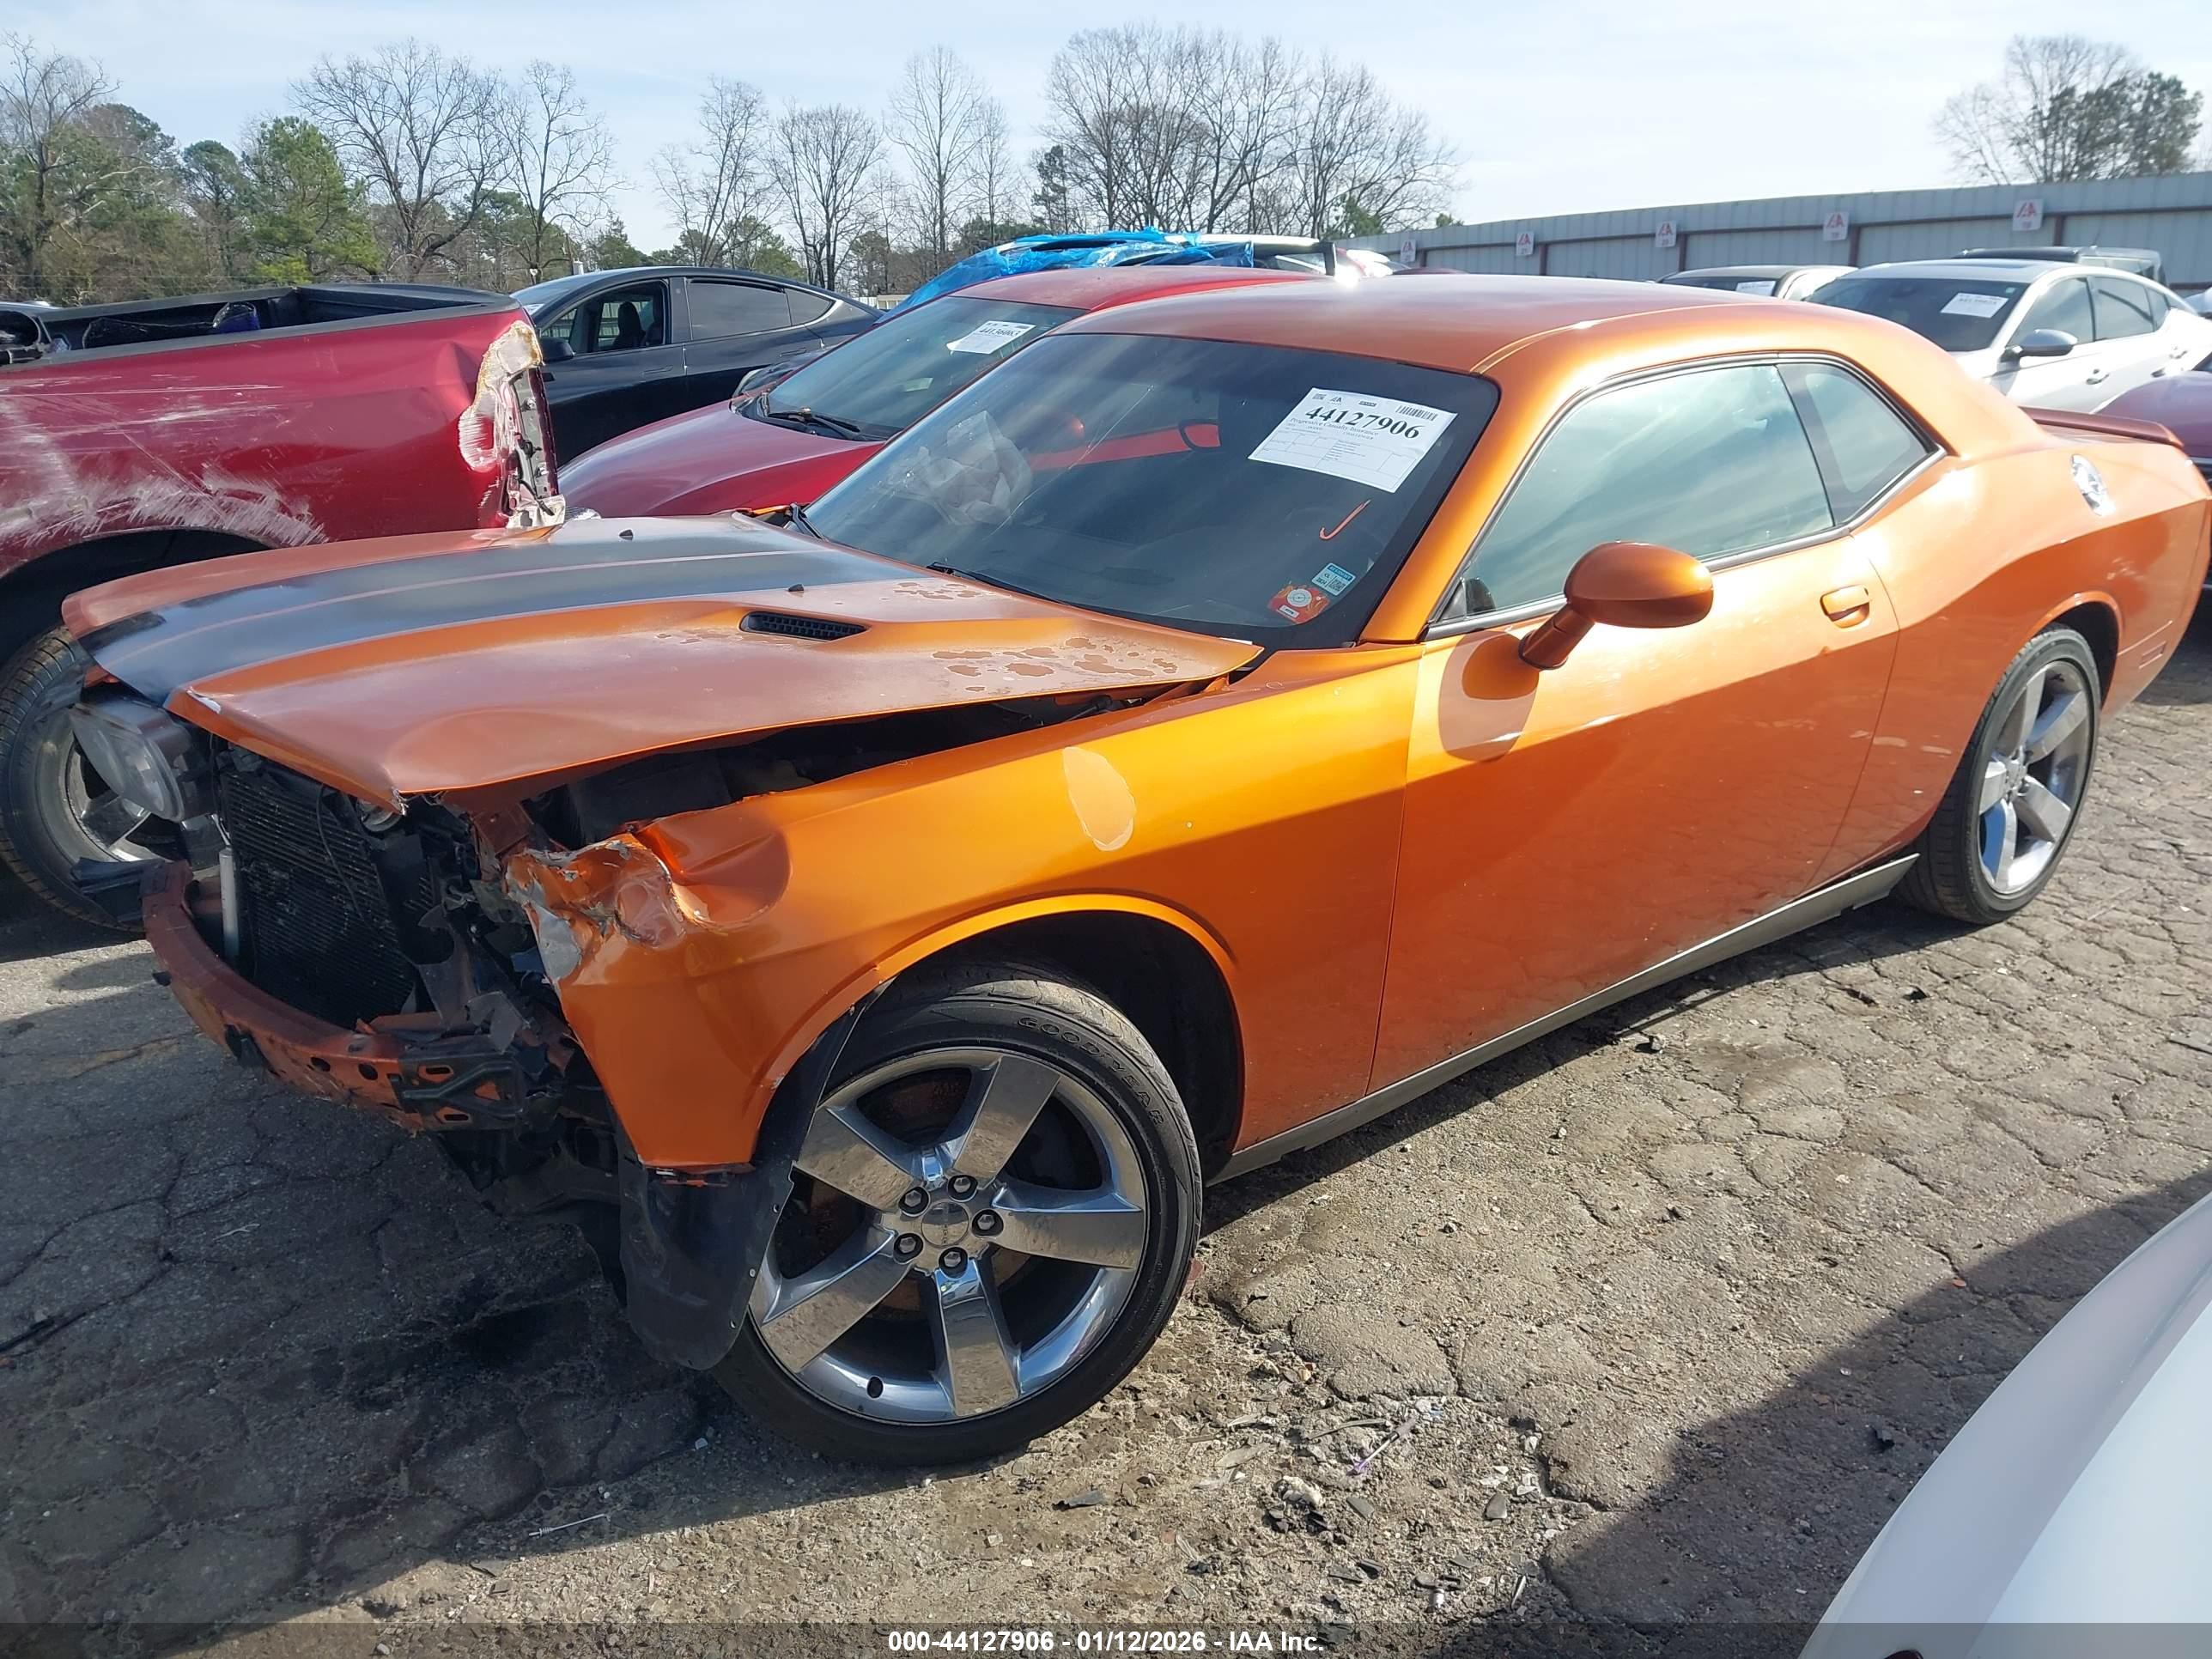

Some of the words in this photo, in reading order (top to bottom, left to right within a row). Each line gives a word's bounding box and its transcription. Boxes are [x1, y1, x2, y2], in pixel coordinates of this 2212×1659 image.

[1290, 417, 1323, 428] Progressive
[1323, 422, 1348, 431] Casualty
[1350, 426, 1380, 436] Insurance
[1305, 406, 1426, 439] 44127906
[1018, 1017, 1164, 1125] GOODYEAR
